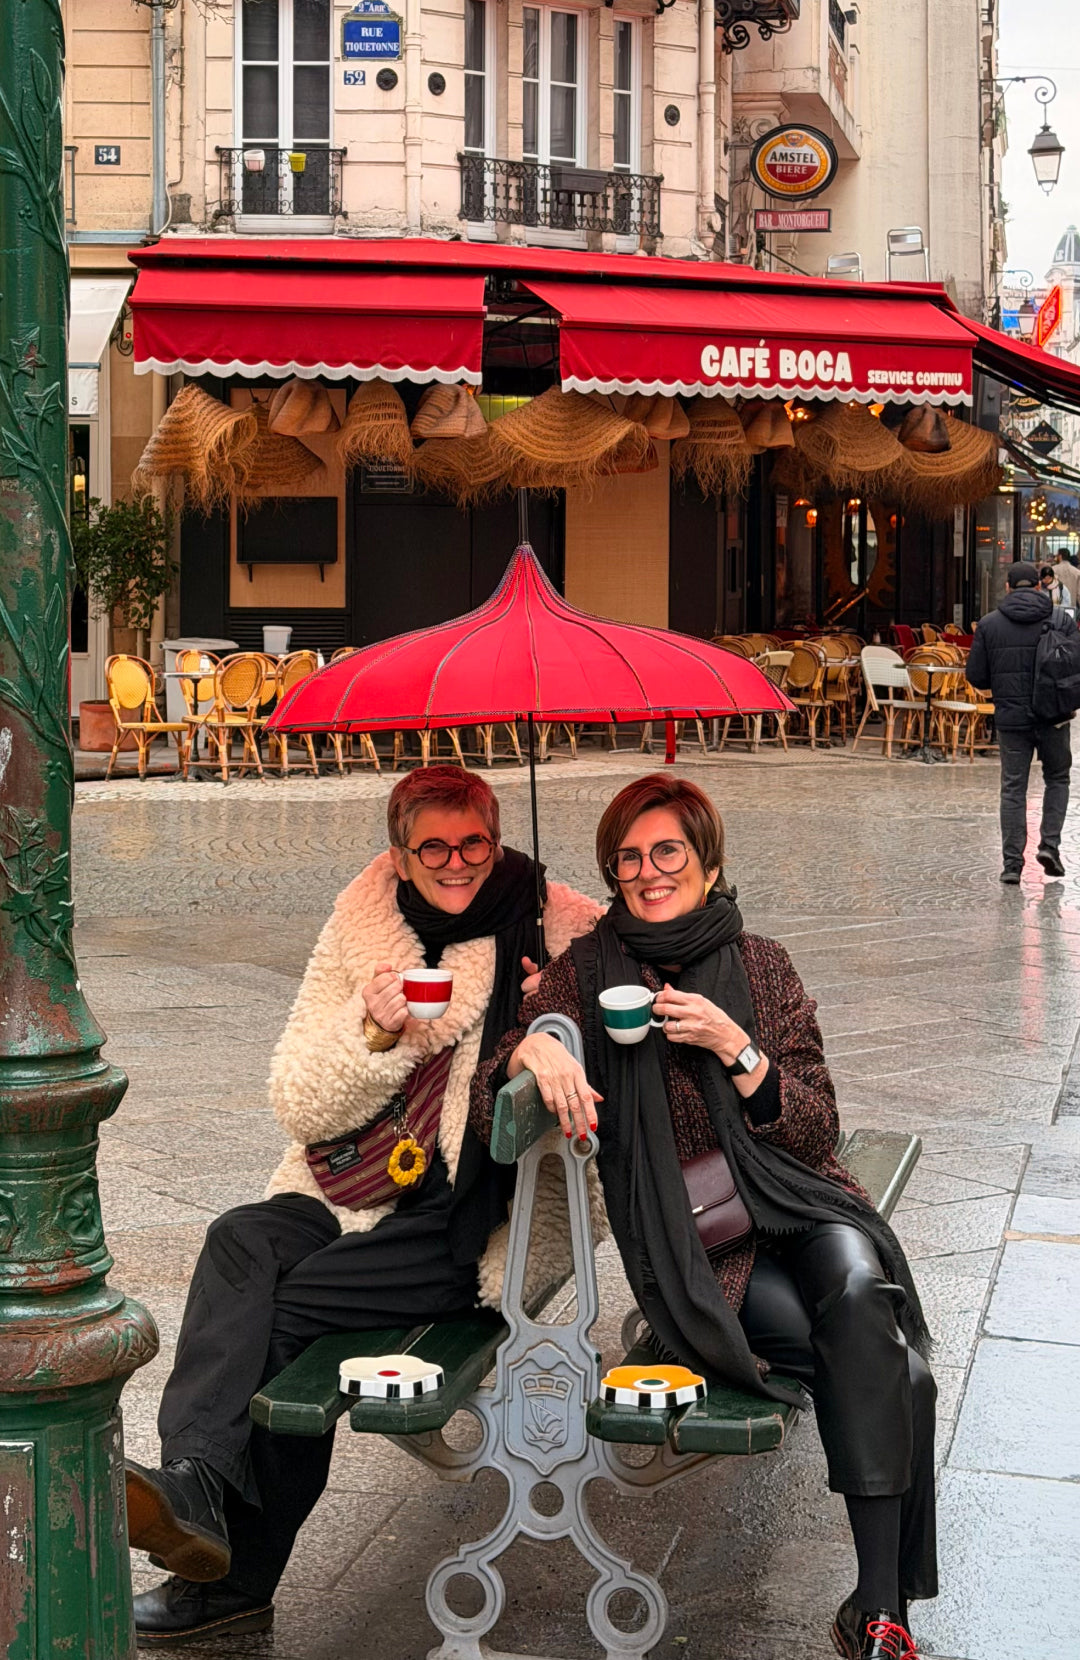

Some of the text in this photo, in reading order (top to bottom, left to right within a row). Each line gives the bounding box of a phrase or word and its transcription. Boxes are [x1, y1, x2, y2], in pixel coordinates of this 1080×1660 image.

[361, 27, 383, 37] RUE
[345, 41, 399, 52] TIQUETONNE
[345, 70, 364, 85] 52
[98, 147, 118, 162] 54
[769, 151, 816, 163] AMSTEL
[776, 165, 808, 174] BIERE
[759, 213, 773, 227] BAR
[700, 339, 853, 382] CAFÉ BOCA
[867, 369, 963, 386] SERVICE CONTINU
